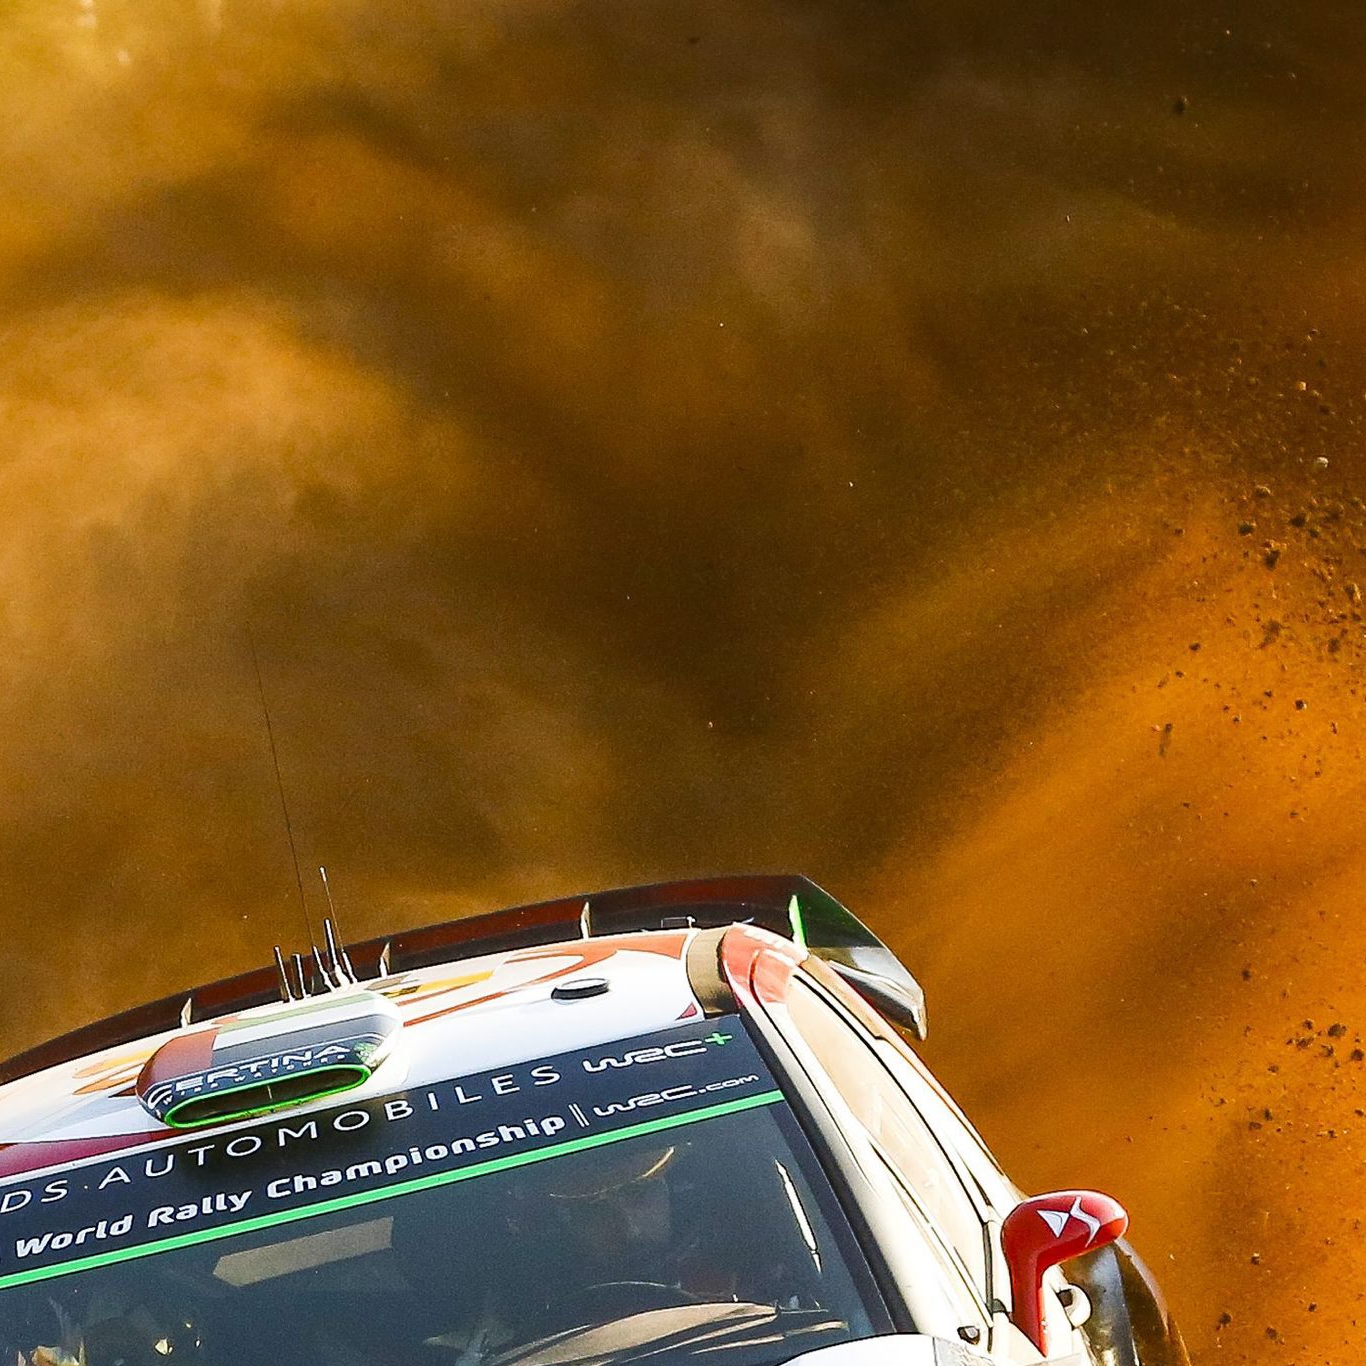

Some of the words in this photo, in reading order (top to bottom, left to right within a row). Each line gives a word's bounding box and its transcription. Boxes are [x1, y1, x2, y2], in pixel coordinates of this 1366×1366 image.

[99, 1065, 561, 1190] AUTOMOBILES
[147, 1045, 351, 1110] CERTINA
[15, 1213, 133, 1258] World
[147, 1188, 253, 1228] Rally
[267, 1115, 566, 1199] Championship
